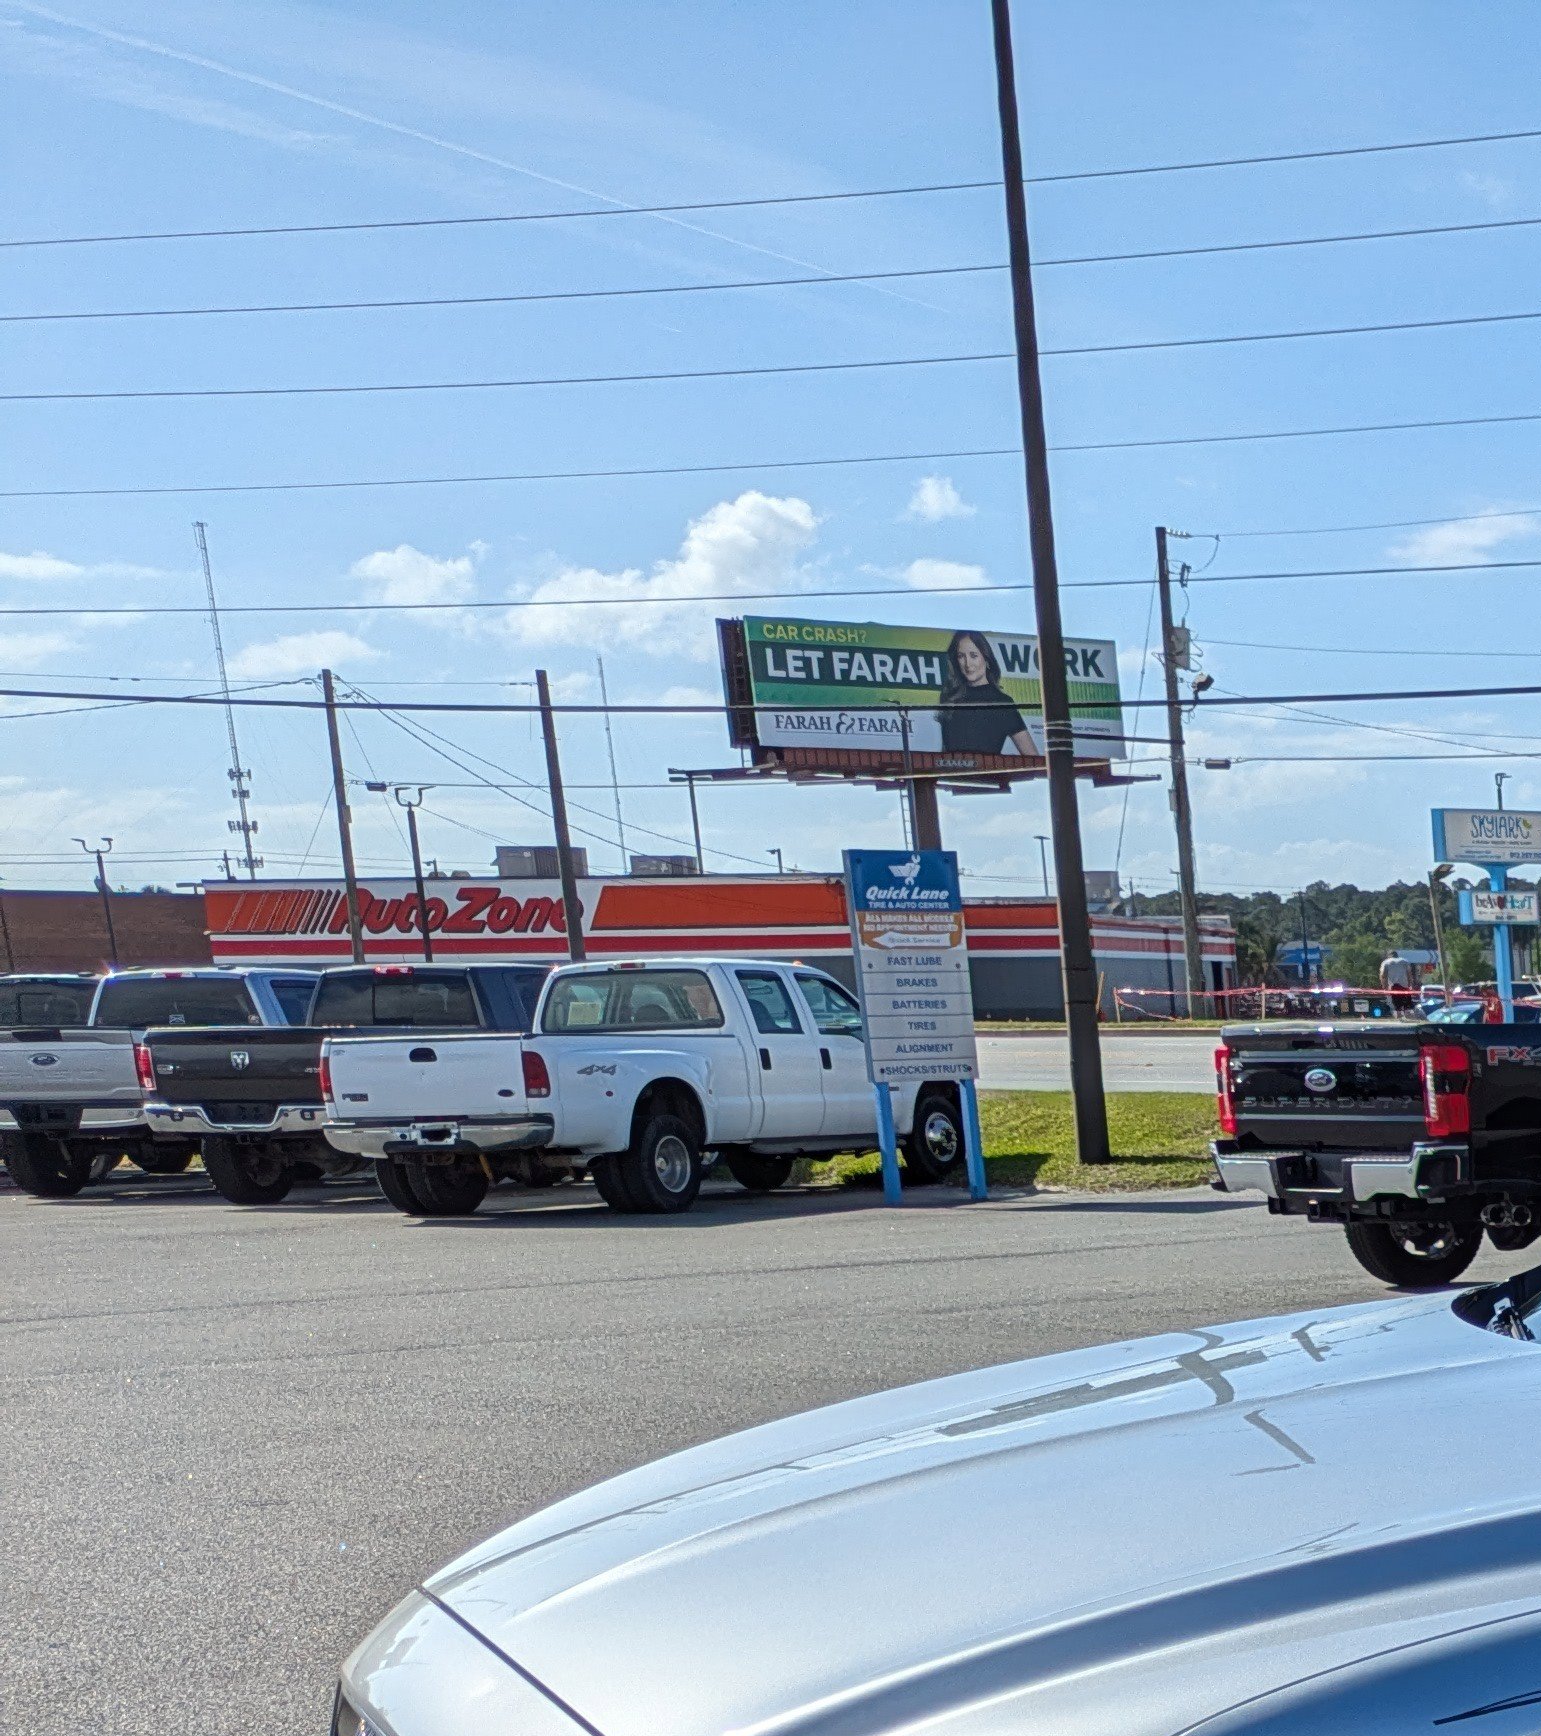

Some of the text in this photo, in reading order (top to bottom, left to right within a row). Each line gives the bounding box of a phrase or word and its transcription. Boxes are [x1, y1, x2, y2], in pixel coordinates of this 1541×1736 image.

[763, 624, 867, 643] CAR CRASH?
[998, 642, 1105, 678] WRK
[765, 648, 942, 686] LET FARAH
[774, 714, 832, 731] FARAH
[836, 712, 856, 735] &
[1471, 814, 1530, 839] SKYLARK
[865, 885, 950, 901] Quick Lane
[868, 901, 886, 909] TIRE
[895, 901, 917, 909] AUTO
[918, 901, 950, 909] CENTER
[887, 956, 942, 966] FAST LUBE
[896, 978, 938, 988] BRAKES
[892, 1000, 948, 1010] BATTERIES
[908, 1021, 937, 1031] TIRES
[895, 1043, 954, 1054] ALIGNMENT
[885, 1064, 968, 1076] SHOCKS/STRUTS
